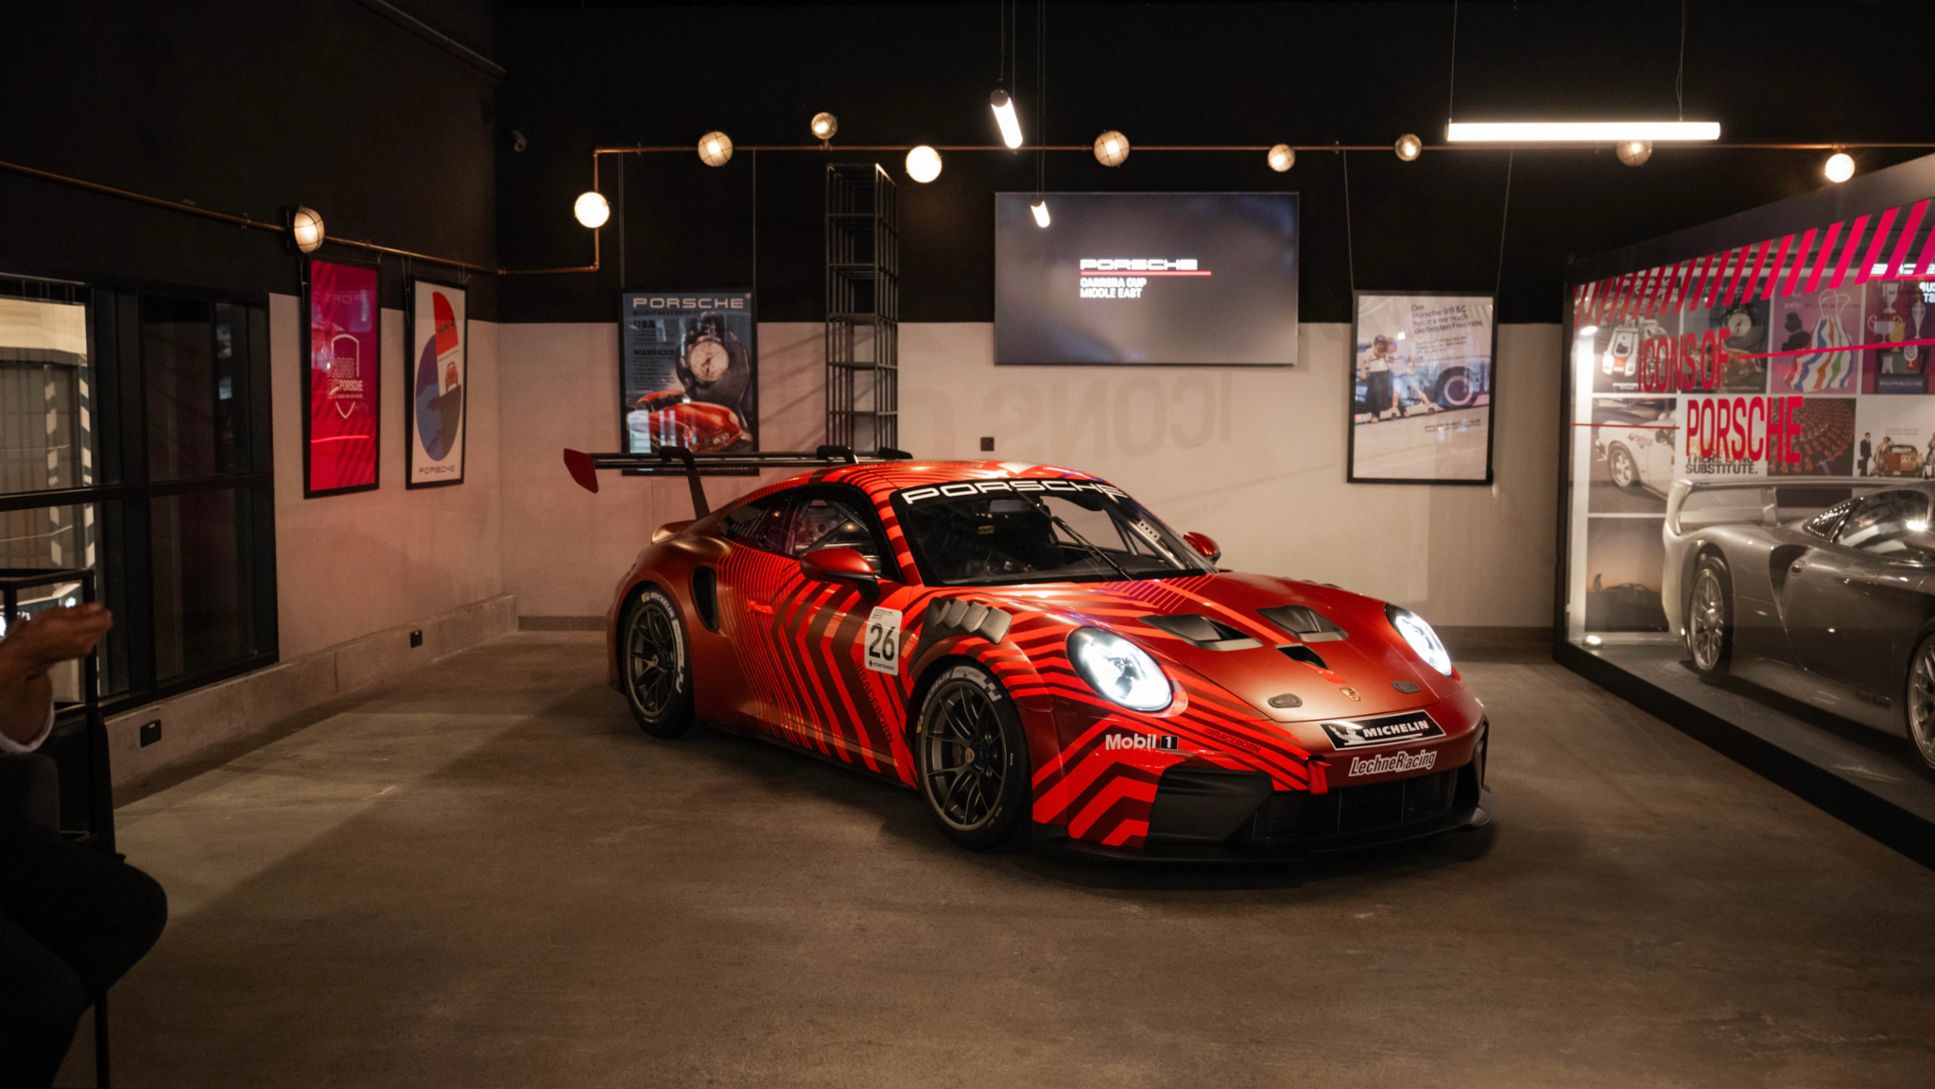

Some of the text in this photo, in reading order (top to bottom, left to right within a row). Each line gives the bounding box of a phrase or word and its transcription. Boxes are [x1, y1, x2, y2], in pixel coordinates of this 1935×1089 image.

[1080, 259, 1198, 270] PORSCHE
[1080, 278, 1147, 287] CARRERA CUP
[1080, 288, 1142, 298] MIDDLE EAST
[633, 297, 744, 309] PORSCHE
[1638, 327, 1731, 393] ICONS OF
[1686, 395, 1804, 464] PORSCHE
[1685, 463, 1758, 475] SUBSTITUTE.
[901, 479, 1129, 506] PORSCHE
[869, 622, 896, 661] 26
[1362, 719, 1429, 740] MICHELIN
[1105, 733, 1157, 751] Mobil
